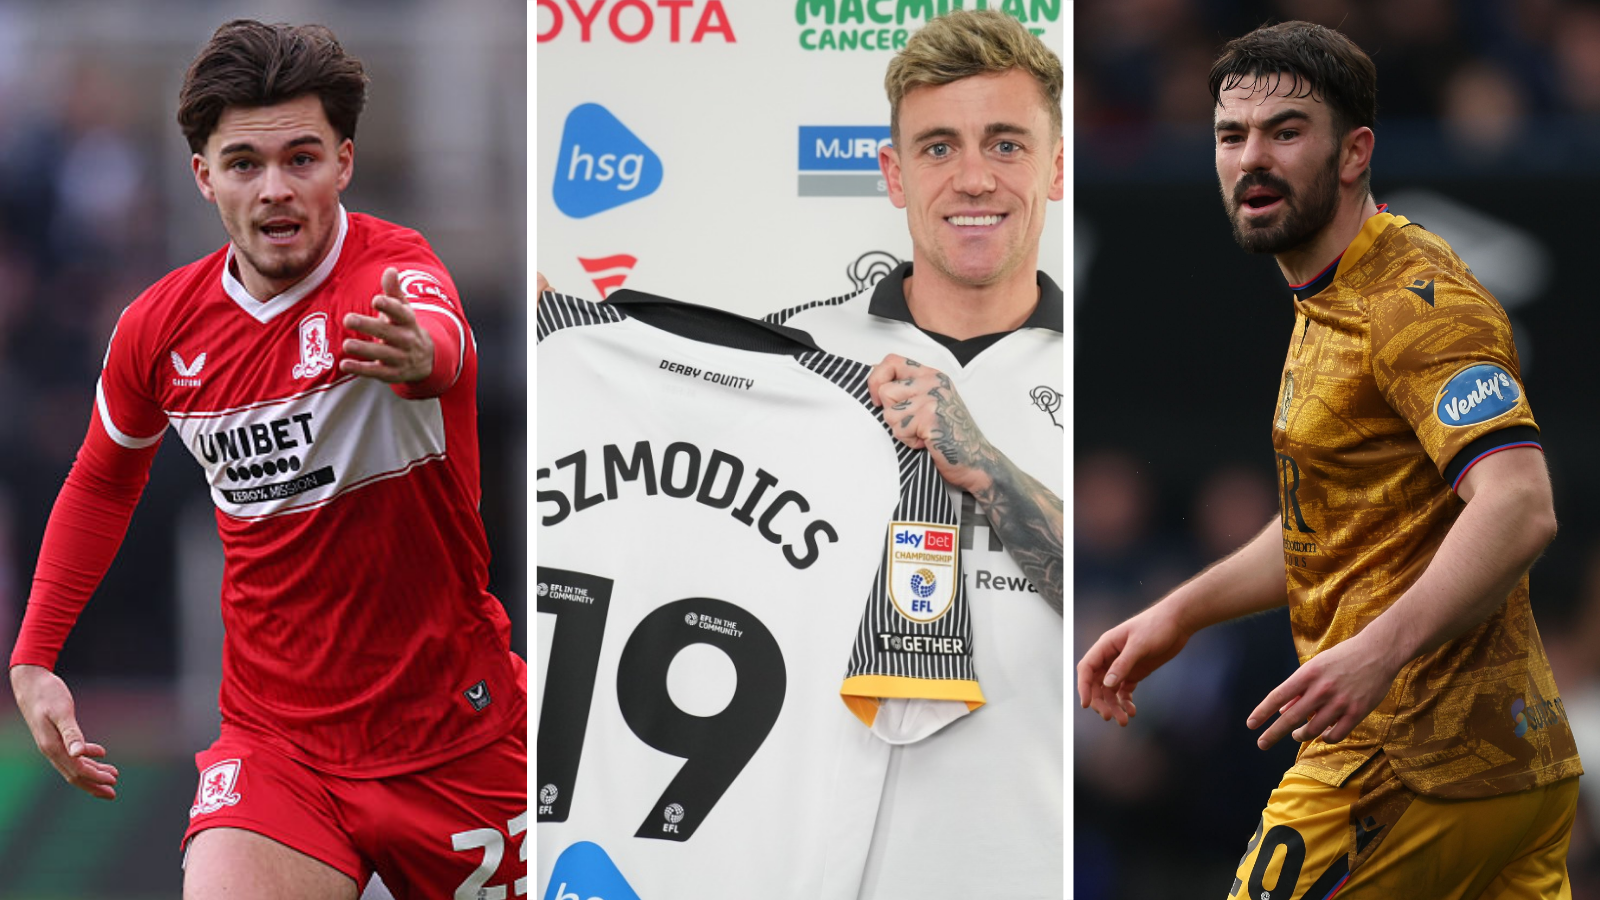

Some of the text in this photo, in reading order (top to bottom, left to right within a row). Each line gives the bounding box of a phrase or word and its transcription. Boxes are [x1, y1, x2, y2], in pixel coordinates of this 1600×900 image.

[795, 0, 1061, 25] MACMAN
[799, 29, 908, 51] CANCER
[568, 144, 644, 191] hsg
[659, 359, 755, 390] DERBY COUNTY
[1444, 372, 1510, 421] Venky's
[199, 412, 313, 464] UNIBET
[269, 476, 318, 498] MISSION
[537, 440, 839, 570] SZMODICS
[895, 530, 950, 548] sky bet
[895, 551, 952, 563] CHAMPIONSHIP
[549, 591, 595, 605] COMMUNITY
[550, 584, 588, 597] EFL IN THE
[911, 600, 933, 613] EFL
[699, 621, 743, 637] COMMUNITY
[700, 614, 737, 630] EFL IN THE
[537, 566, 787, 842] 19
[538, 805, 553, 815] EFL
[662, 823, 679, 834] EFL
